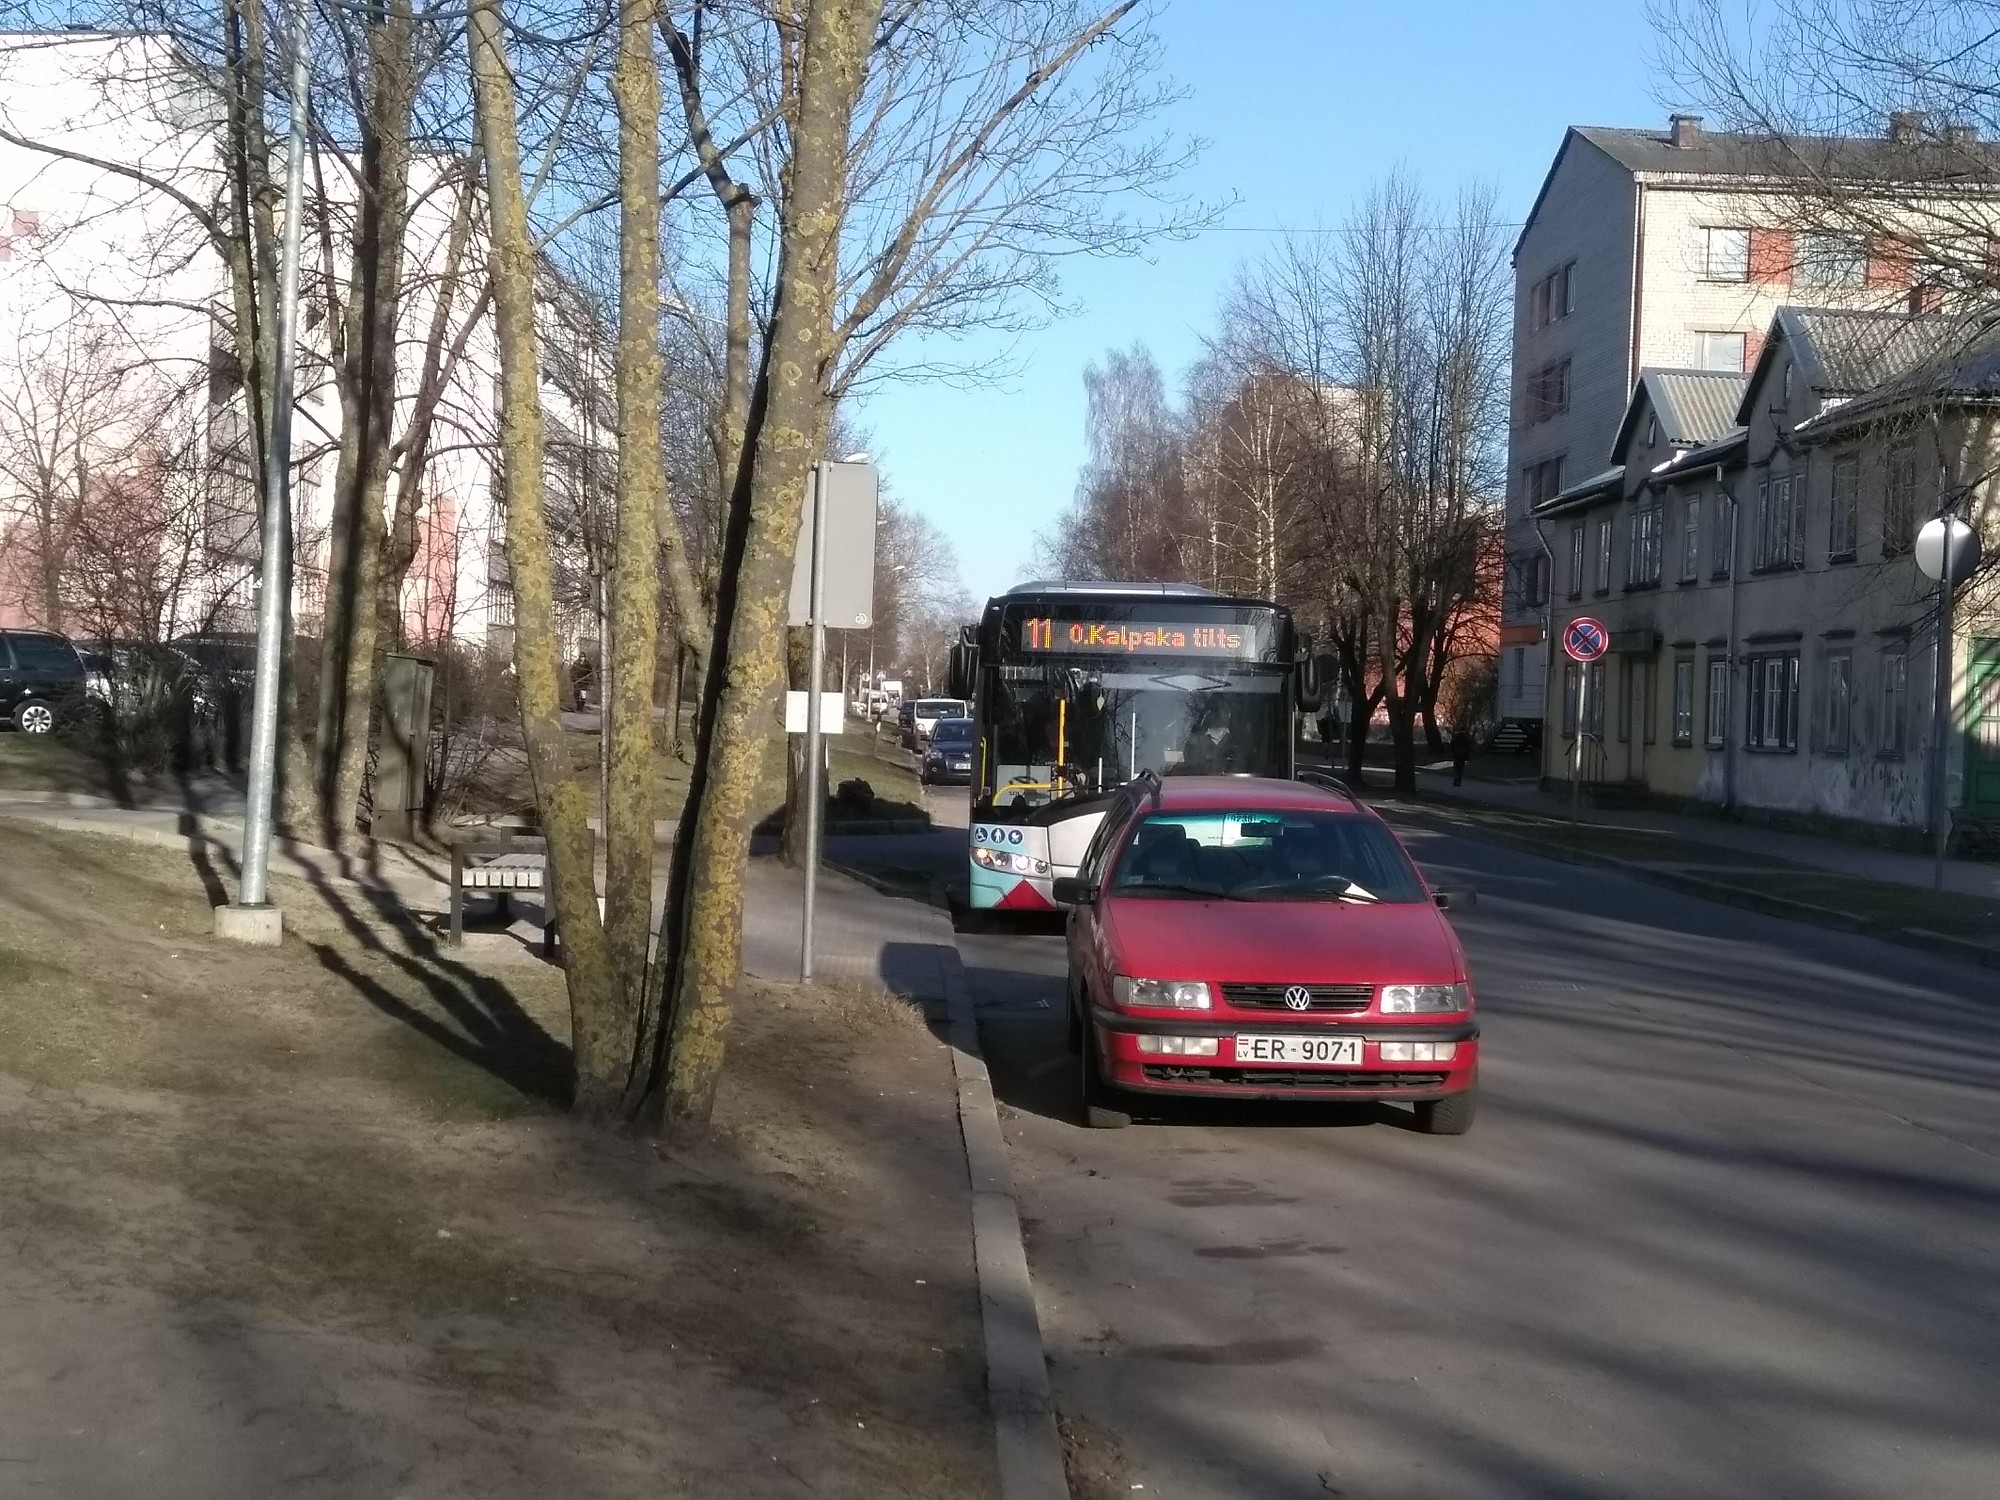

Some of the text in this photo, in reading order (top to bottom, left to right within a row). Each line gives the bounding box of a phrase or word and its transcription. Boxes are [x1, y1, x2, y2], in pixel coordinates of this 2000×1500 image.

[1027, 618, 1241, 651] 11 O.Kalpaka tilts
[1238, 1050, 1248, 1058] LV
